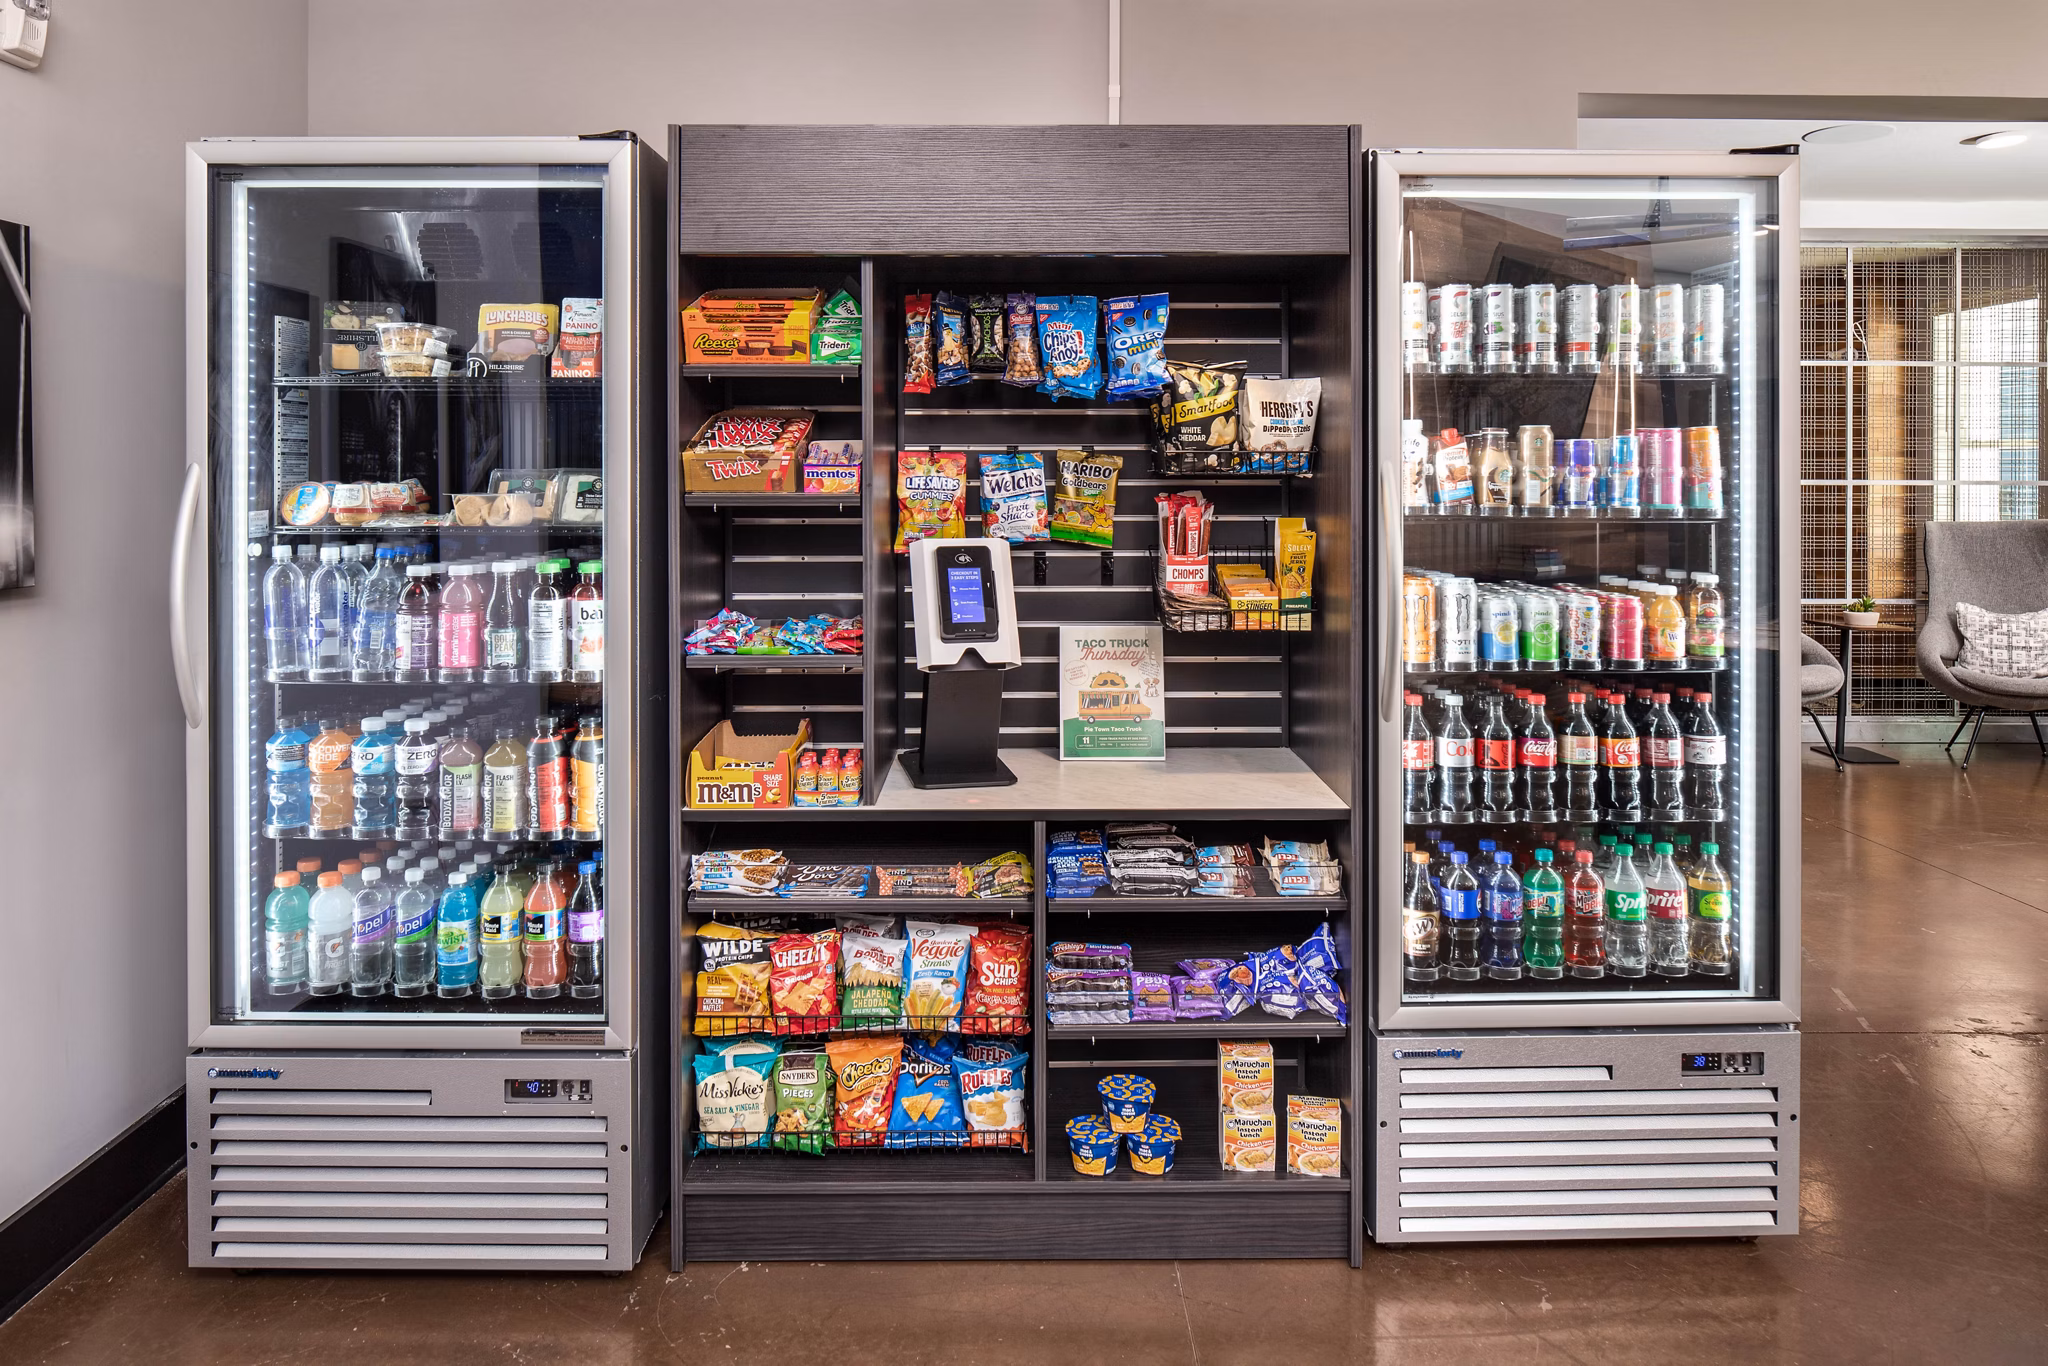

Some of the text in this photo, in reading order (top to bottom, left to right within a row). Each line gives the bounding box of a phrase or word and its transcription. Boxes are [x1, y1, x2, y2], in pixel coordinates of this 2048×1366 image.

[486, 309, 549, 326] LUNCHABLES
[1047, 322, 1073, 331] Mini
[693, 333, 740, 349] Reese's
[819, 341, 851, 349] Trident
[1043, 330, 1077, 352] Chips
[1113, 331, 1164, 350] OREO
[1127, 340, 1159, 355] mini
[1180, 426, 1202, 434] WHITE
[1178, 434, 1206, 442] CHEDDAR
[706, 456, 762, 481] Twix
[805, 469, 856, 479] mentos
[1061, 462, 1113, 479] HARIBO
[986, 472, 1043, 495] Welch's
[1062, 478, 1108, 491] Goldbears
[909, 491, 955, 501] GUMMIES
[1006, 502, 1030, 514] Fruit
[1000, 510, 1035, 524] Snacks
[1287, 544, 1312, 552] SOLELY
[1172, 568, 1204, 580] CHOMPS
[1245, 602, 1273, 610] STINGER
[451, 615, 459, 666] vitaminwater
[1075, 639, 1149, 648] TACO TRUCK
[494, 643, 514, 652] PEAK
[1080, 647, 1146, 667] Thursday
[1082, 736, 1090, 744] 11
[407, 748, 437, 761] ZERO
[697, 782, 762, 805] m&m's
[443, 774, 453, 828] BODYARMOR
[791, 872, 838, 882] Dove
[1648, 893, 1682, 907] prite
[701, 939, 764, 958] WILDE
[912, 938, 965, 960] Veggie
[774, 942, 829, 968] CHEEZ-IT
[853, 949, 895, 969] BOULDER
[919, 959, 952, 969] Straws
[783, 971, 813, 986] ORIGINAL
[917, 970, 933, 978] Zesty
[980, 959, 1020, 986] Sun
[706, 975, 722, 985] REAL
[993, 978, 1018, 986] CHIPS
[851, 989, 892, 999] JALAPEÑO
[702, 1004, 722, 1012] WAFFLES
[853, 998, 889, 1008] CHEDDAR
[966, 1045, 1013, 1062] RUFFLES
[1403, 1048, 1464, 1059] minusforty
[900, 1062, 952, 1075] Doritos
[1232, 1060, 1270, 1068] Maruchan
[217, 1067, 279, 1079] minusforty
[781, 1071, 816, 1081] SNYDER'S
[842, 1057, 893, 1090] Cheetos
[527, 1082, 539, 1093] 40
[961, 1069, 1012, 1094] RUFFLES
[1234, 1081, 1260, 1089] Chicken
[700, 1077, 764, 1099] Miss Vickie's
[782, 1089, 814, 1099] PIECES
[703, 1102, 760, 1114] SEA SALT & VINEGAR
[1234, 1119, 1272, 1127] Maruchan
[1298, 1121, 1337, 1132] Maruchan
[1301, 1129, 1328, 1138] Instant
[1237, 1140, 1263, 1148] Chicken
[1301, 1142, 1327, 1151] Chicken
